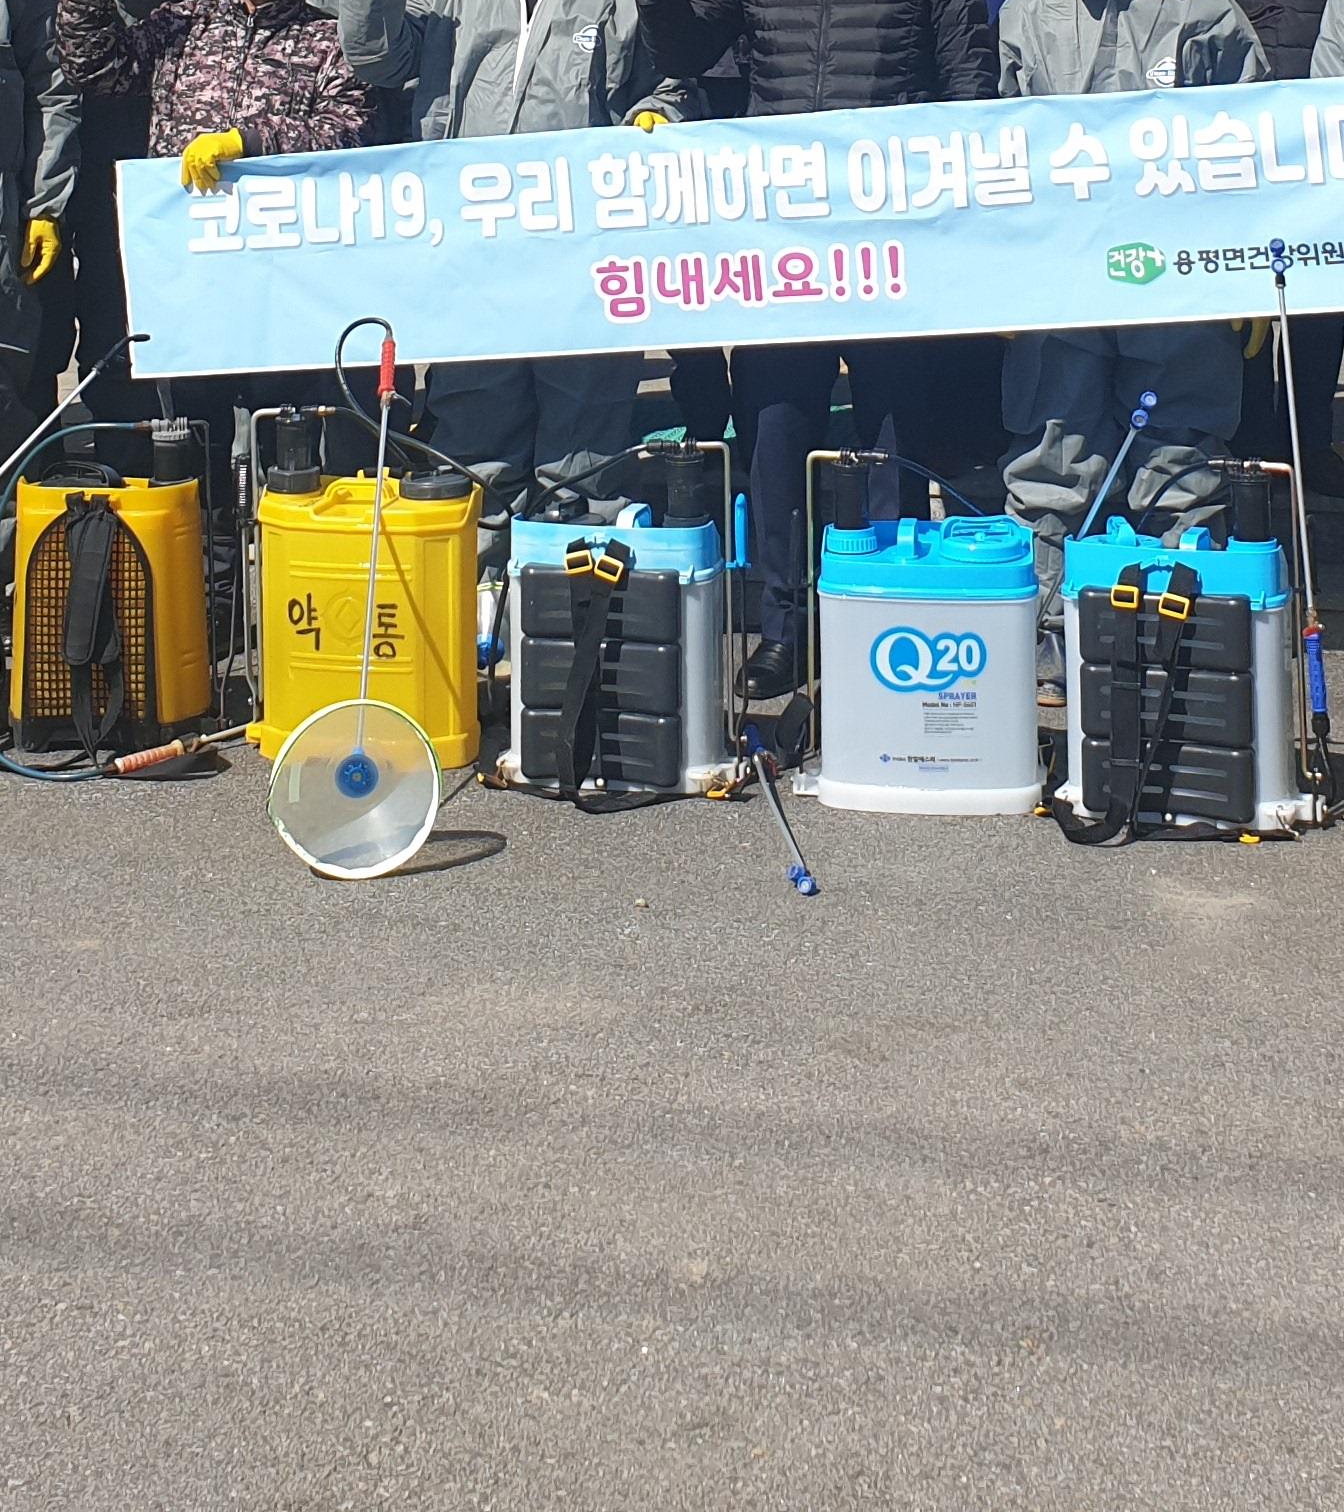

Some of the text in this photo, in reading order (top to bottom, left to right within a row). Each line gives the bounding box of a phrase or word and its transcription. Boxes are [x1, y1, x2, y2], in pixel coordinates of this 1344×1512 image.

[187, 171, 445, 254] 코로나19,
[458, 155, 576, 238] 우리
[587, 139, 831, 231] 함께하면
[847, 123, 1035, 213] 이겨낼
[1048, 121, 1112, 201] 수
[594, 242, 904, 319] 힘내세요!!!
[288, 592, 405, 658] 약 통
[875, 631, 981, 686] Q20
[938, 691, 977, 700] SPRAYER
